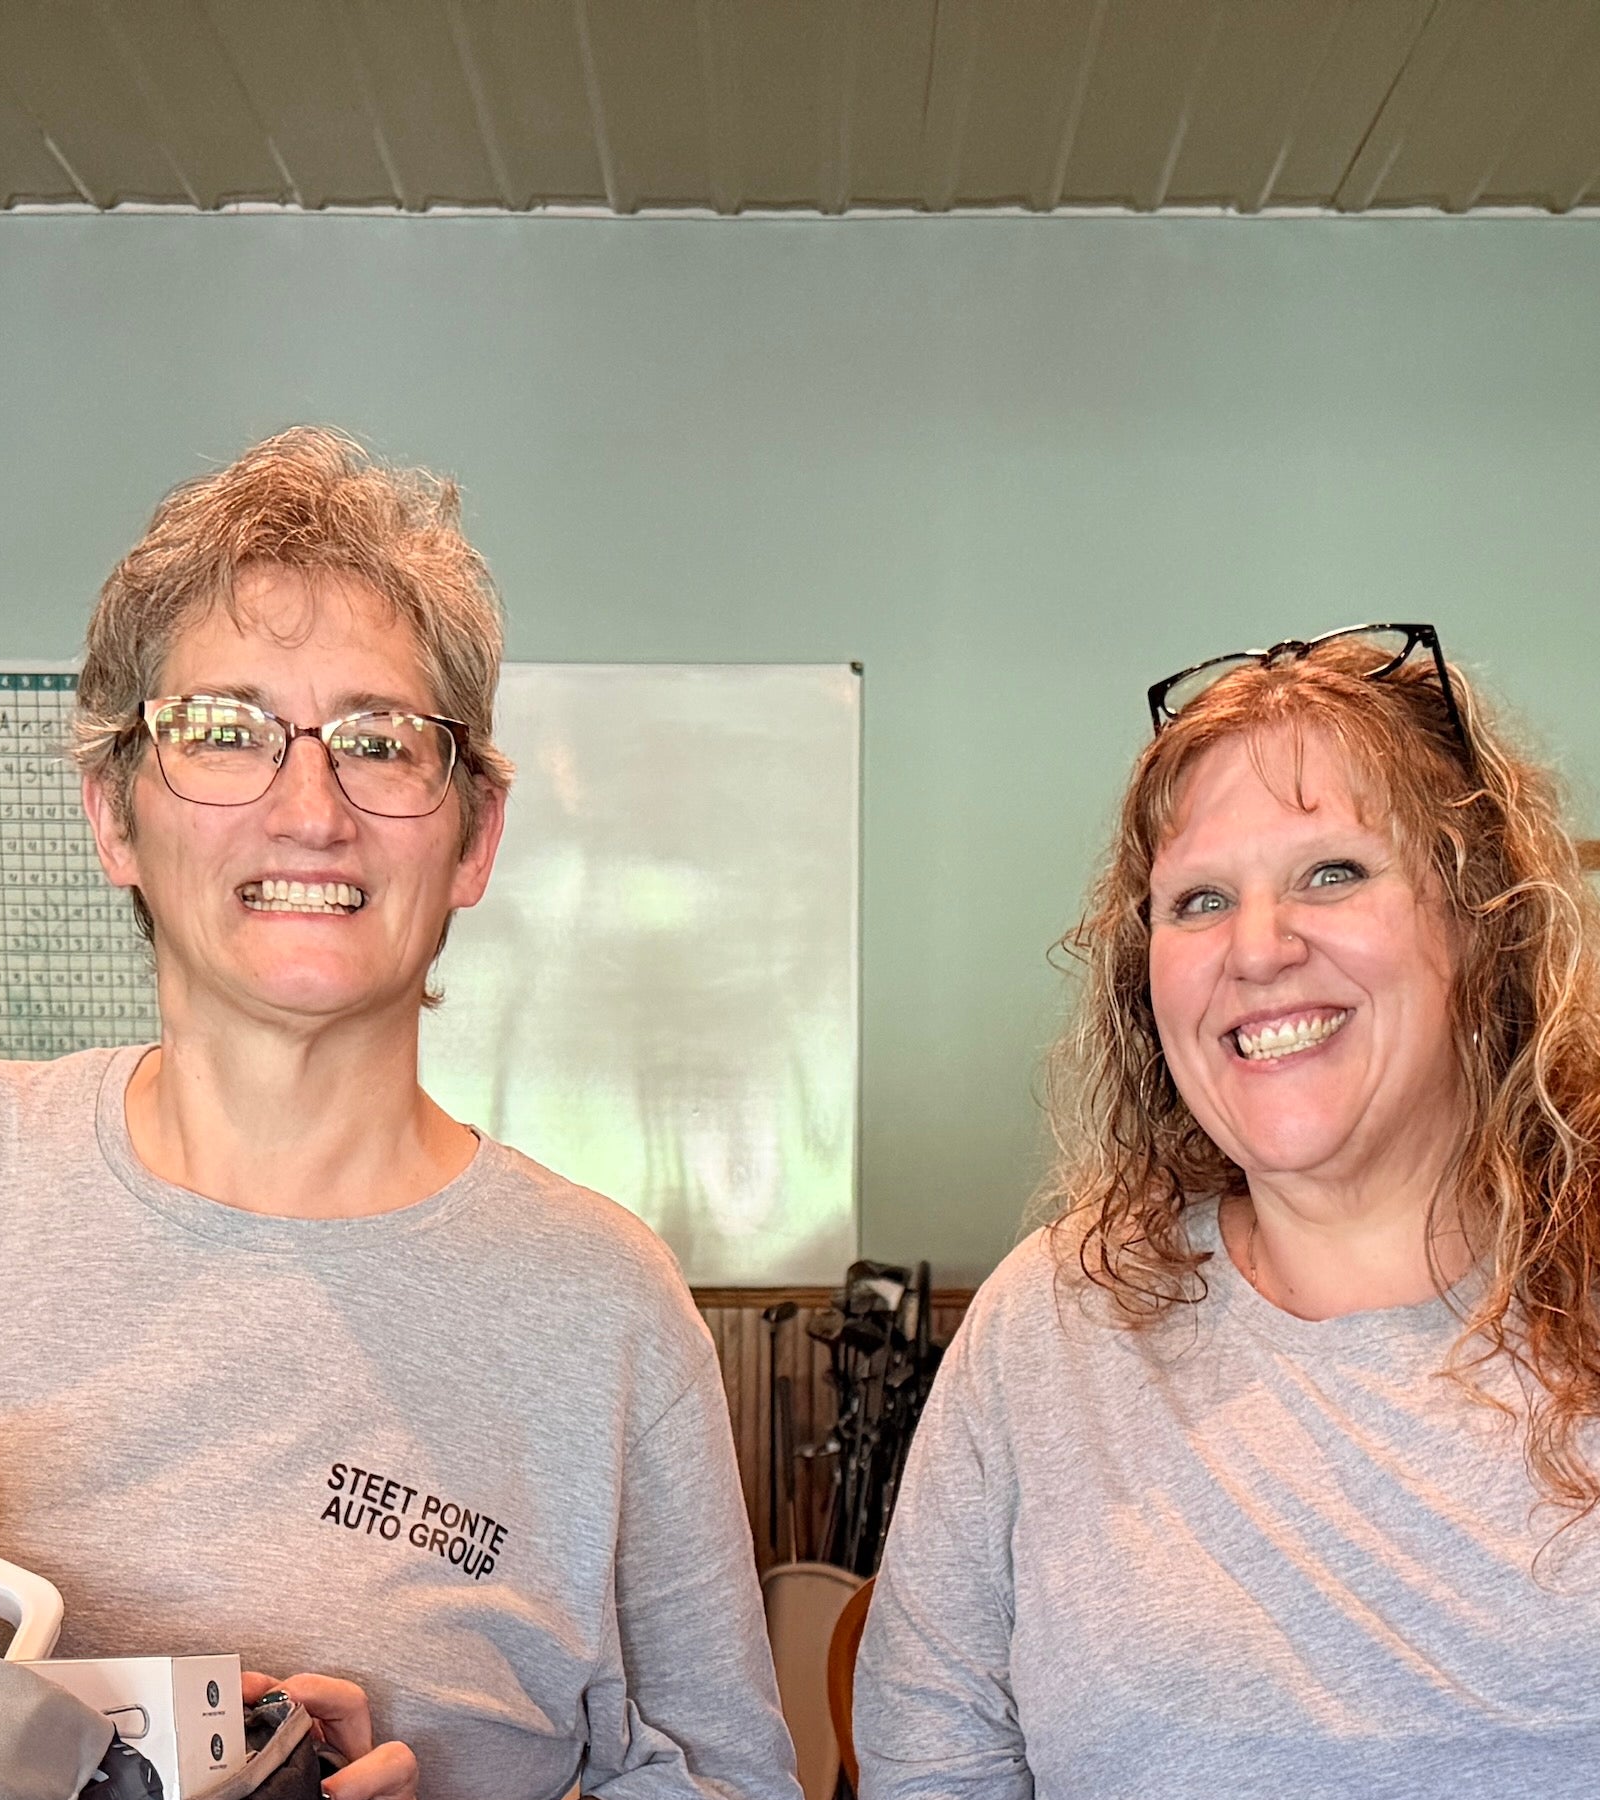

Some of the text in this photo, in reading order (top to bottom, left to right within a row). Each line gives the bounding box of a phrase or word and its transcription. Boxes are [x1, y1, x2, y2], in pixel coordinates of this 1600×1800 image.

[321, 1496, 496, 1581] AUTO GROUP
[327, 1463, 509, 1556] STEET PONTE
